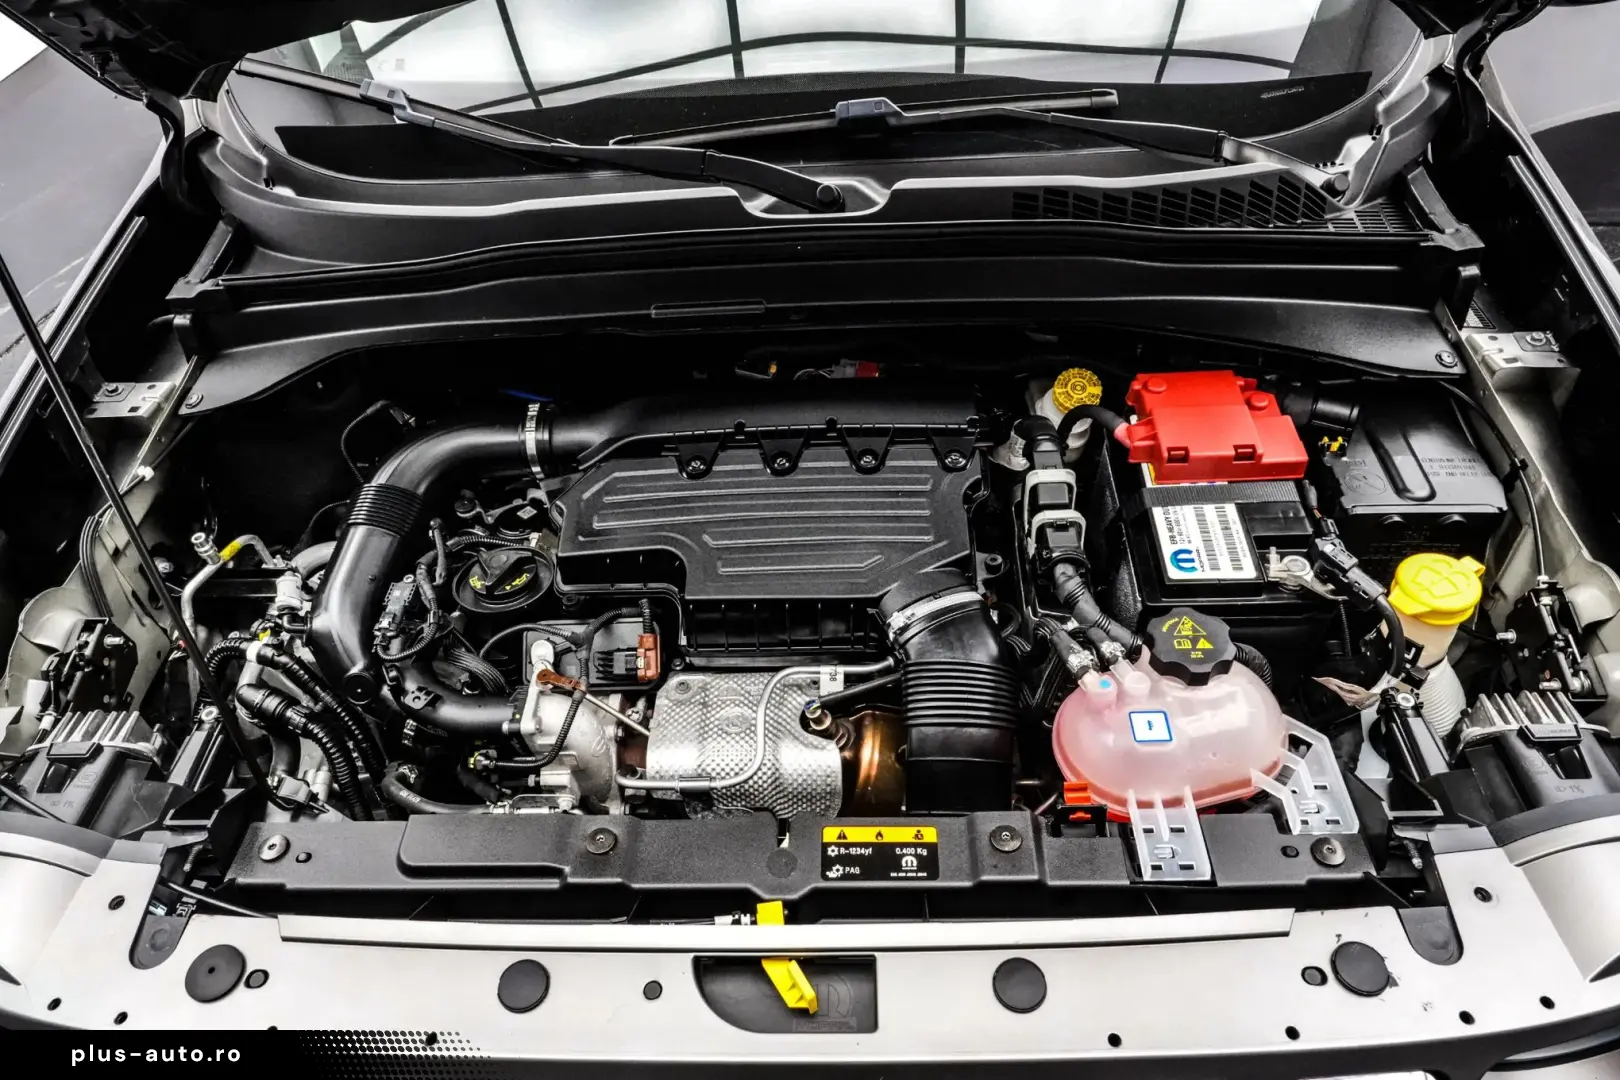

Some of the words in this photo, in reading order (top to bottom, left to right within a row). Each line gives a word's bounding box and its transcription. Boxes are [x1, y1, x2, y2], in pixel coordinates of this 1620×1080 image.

[840, 847, 872, 856] R-1234yf
[895, 847, 915, 855] 0.400
[916, 847, 928, 856] Kg
[845, 866, 860, 874] PAG
